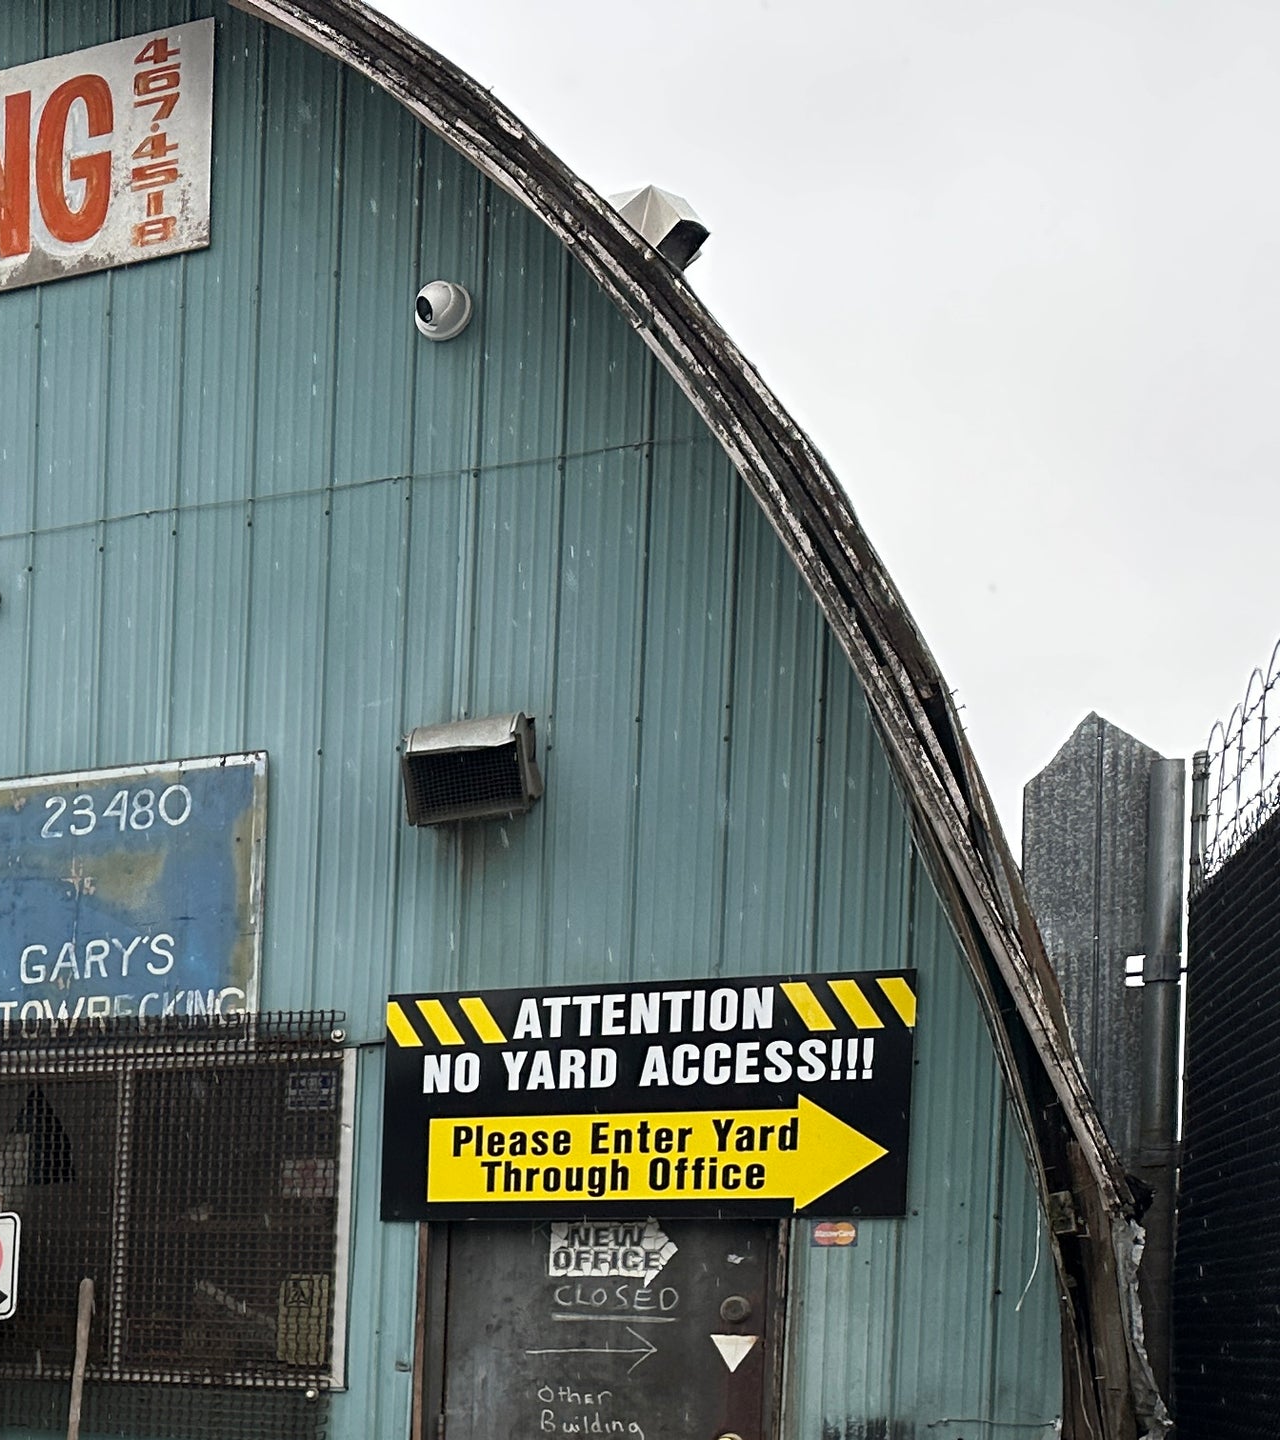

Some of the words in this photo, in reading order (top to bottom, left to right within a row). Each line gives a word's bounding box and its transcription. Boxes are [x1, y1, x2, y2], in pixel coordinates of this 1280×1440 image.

[40, 784, 192, 839] 23480
[19, 932, 176, 985] GARY'S
[512, 986, 775, 1040] ATTENTION
[422, 1052, 481, 1094] NO
[501, 1047, 618, 1091] YARD
[638, 1037, 876, 1087] ACCESS!!!
[452, 1125, 572, 1158] Please
[590, 1120, 693, 1155] Enter
[712, 1117, 799, 1152] Yard
[480, 1158, 630, 1198] Through
[648, 1156, 766, 1191] Office
[568, 1225, 643, 1247] NEW
[552, 1247, 661, 1271] OFFICE
[553, 1284, 680, 1311] CLOSED
